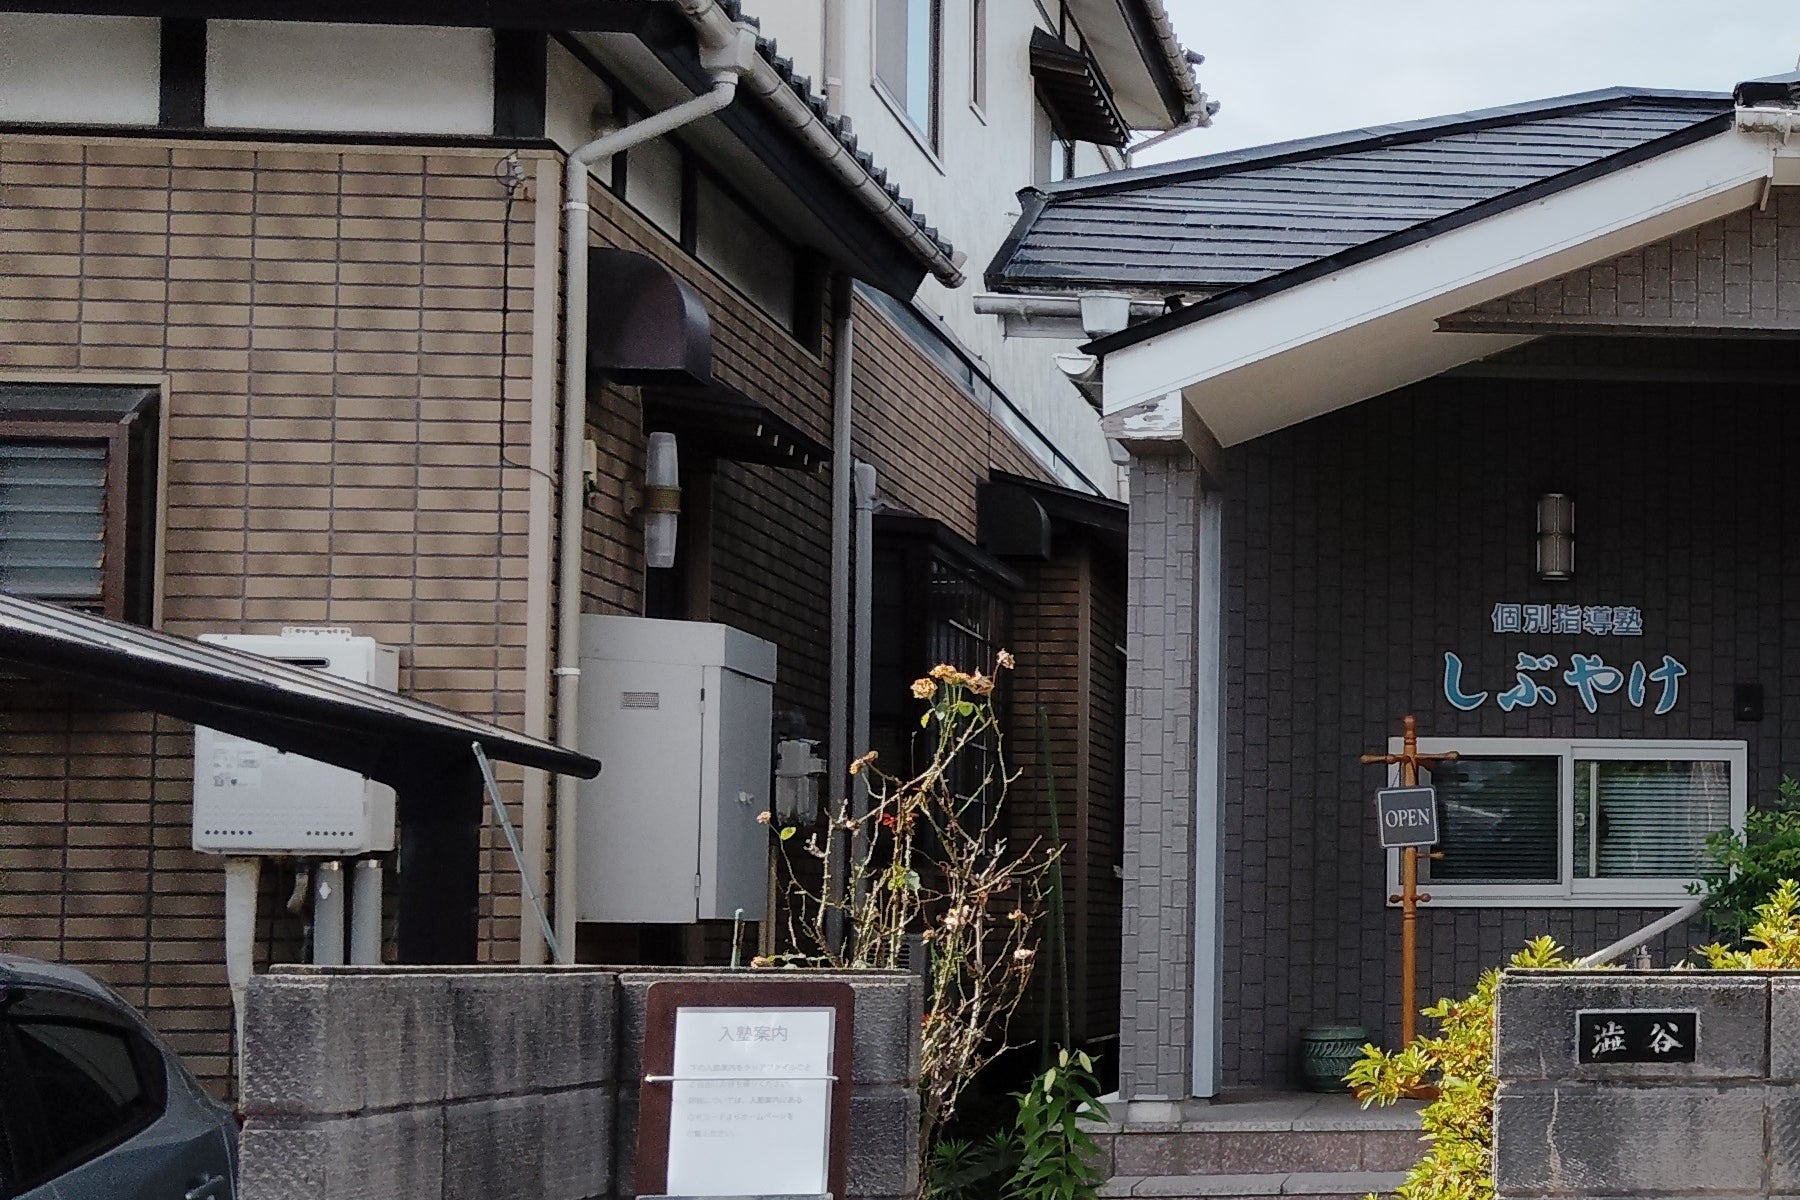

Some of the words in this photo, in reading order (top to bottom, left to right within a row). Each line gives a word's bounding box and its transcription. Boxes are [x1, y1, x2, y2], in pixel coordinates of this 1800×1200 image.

[1491, 603, 1643, 635] 個別指導塾
[1444, 651, 1688, 715] しぶやけ
[1385, 808, 1430, 828] OPEN
[718, 1025, 788, 1042] 入塾案内
